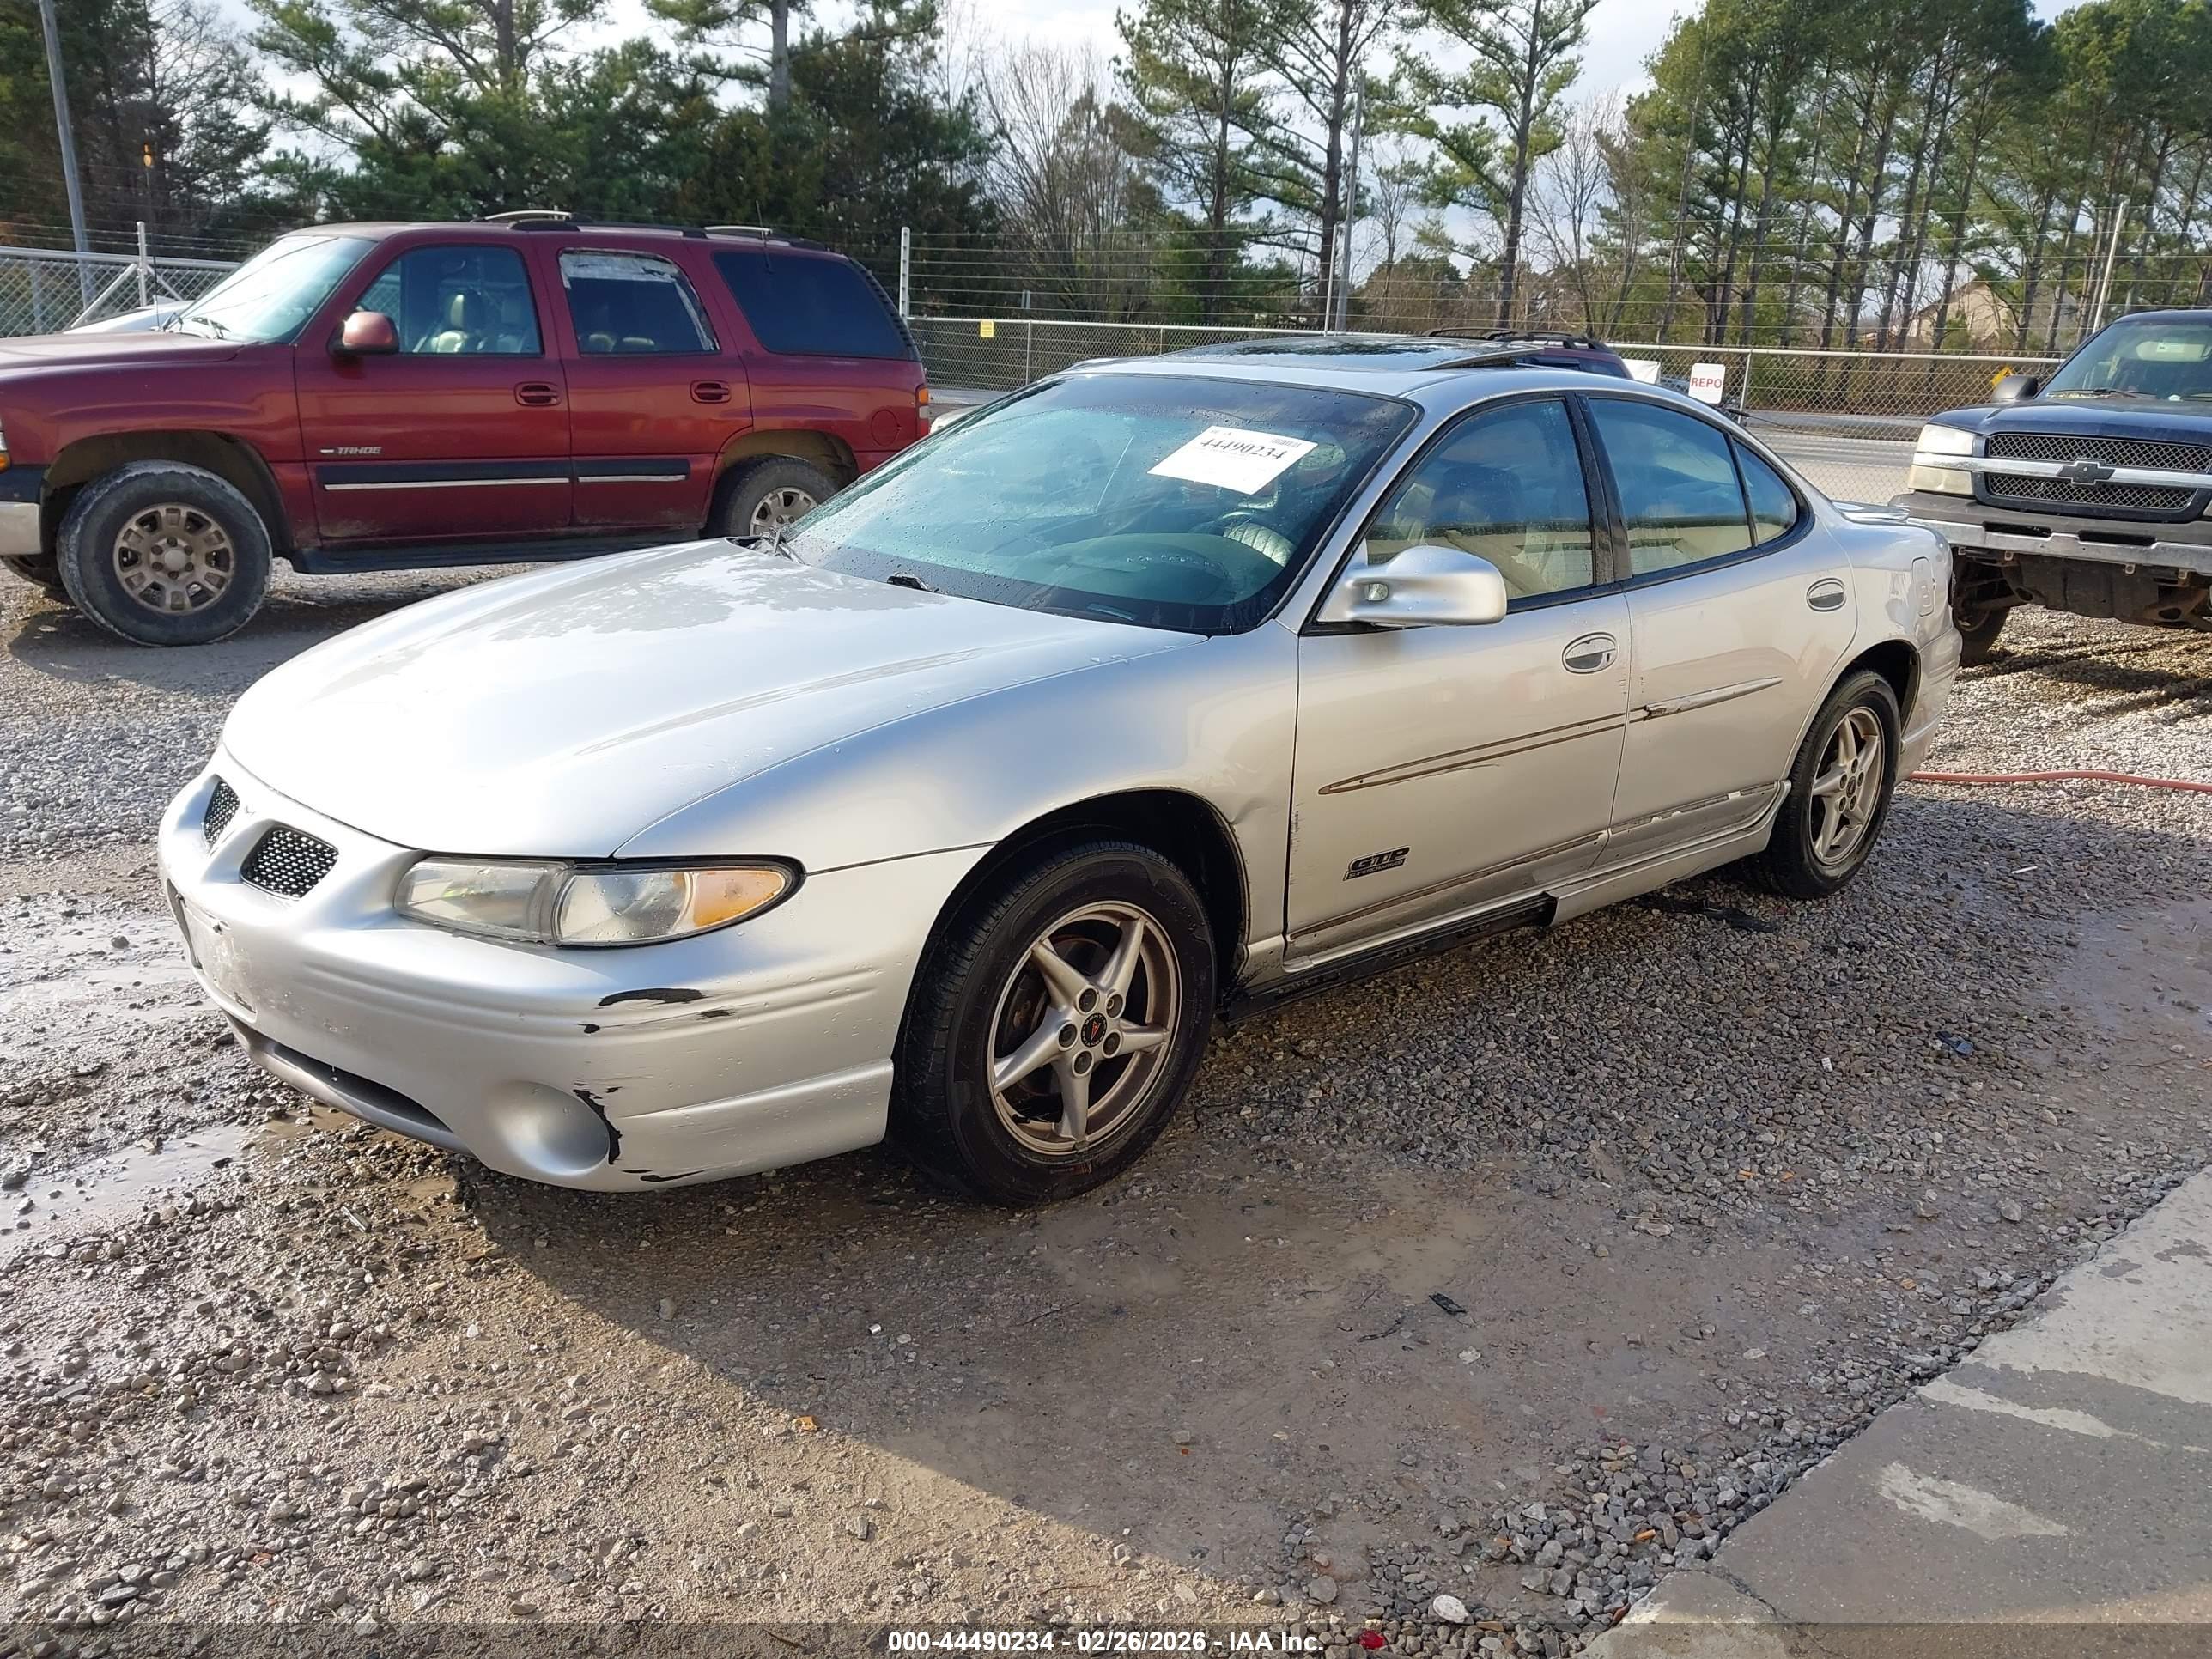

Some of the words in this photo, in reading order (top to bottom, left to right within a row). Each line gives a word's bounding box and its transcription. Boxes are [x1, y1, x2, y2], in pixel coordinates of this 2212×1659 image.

[1691, 377, 1723, 389] REPO
[337, 446, 382, 455] TAHOE
[1200, 438, 1288, 460] 44490234
[1351, 847, 1410, 870] GTP
